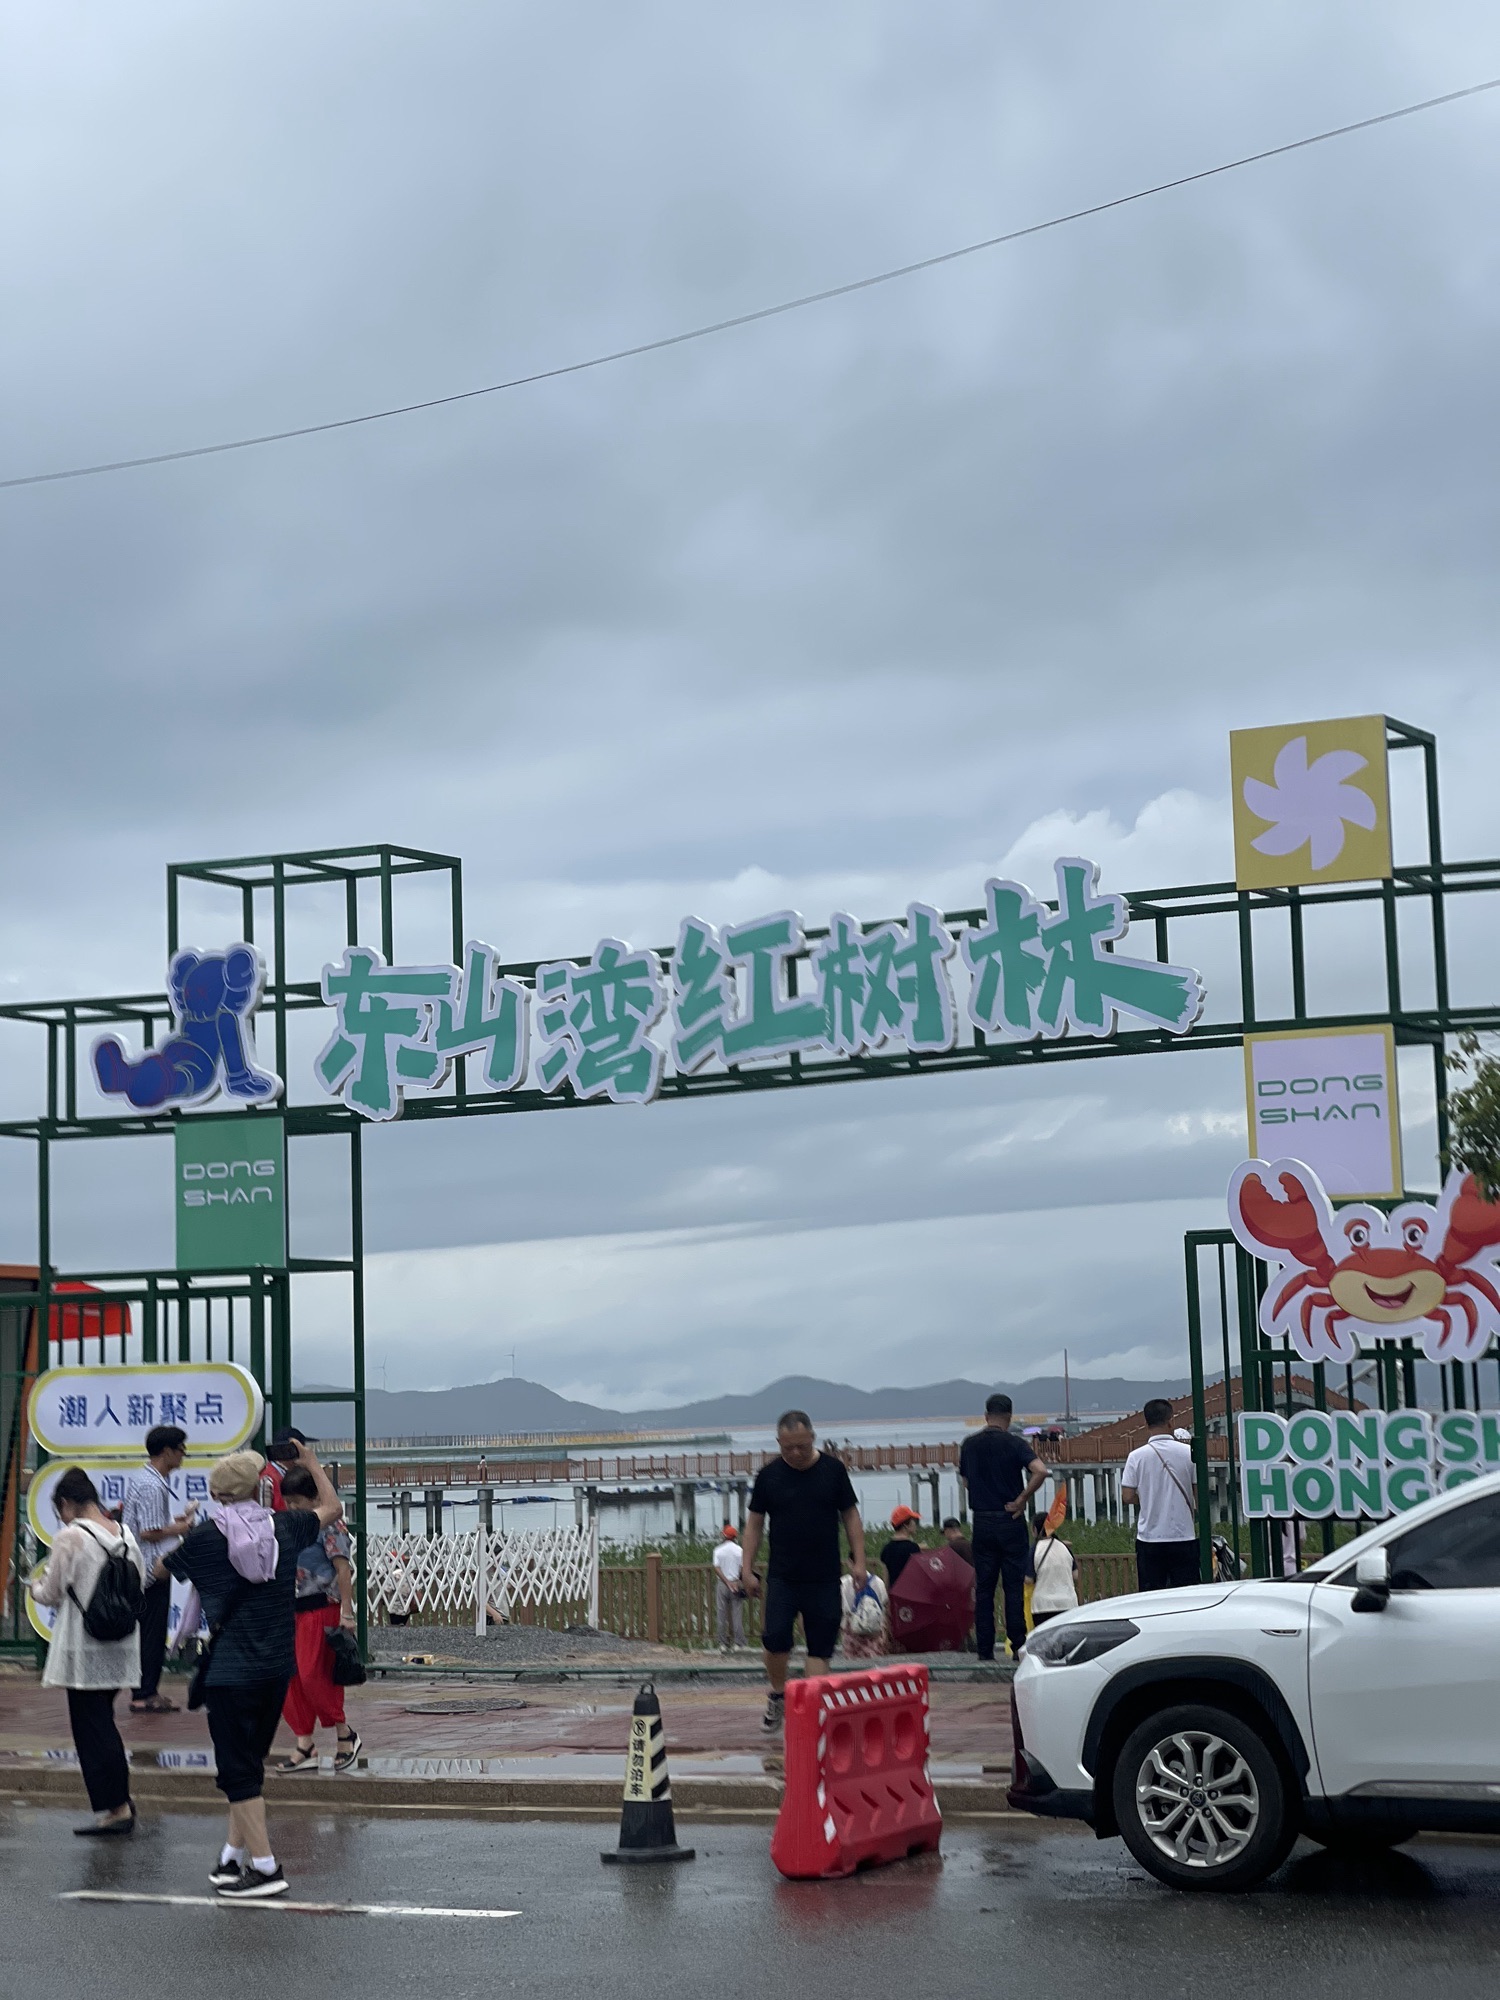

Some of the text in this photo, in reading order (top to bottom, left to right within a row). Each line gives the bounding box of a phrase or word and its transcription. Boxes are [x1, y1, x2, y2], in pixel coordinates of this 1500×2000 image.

[320, 865, 1191, 1112] 东山湾红树林
[1258, 1074, 1383, 1096] DONG
[1259, 1103, 1380, 1124] SHAN
[183, 1159, 275, 1180] DONG
[183, 1186, 273, 1207] SHAN
[58, 1391, 224, 1428] 潮人新聚点
[1244, 1416, 1428, 1461] DONG
